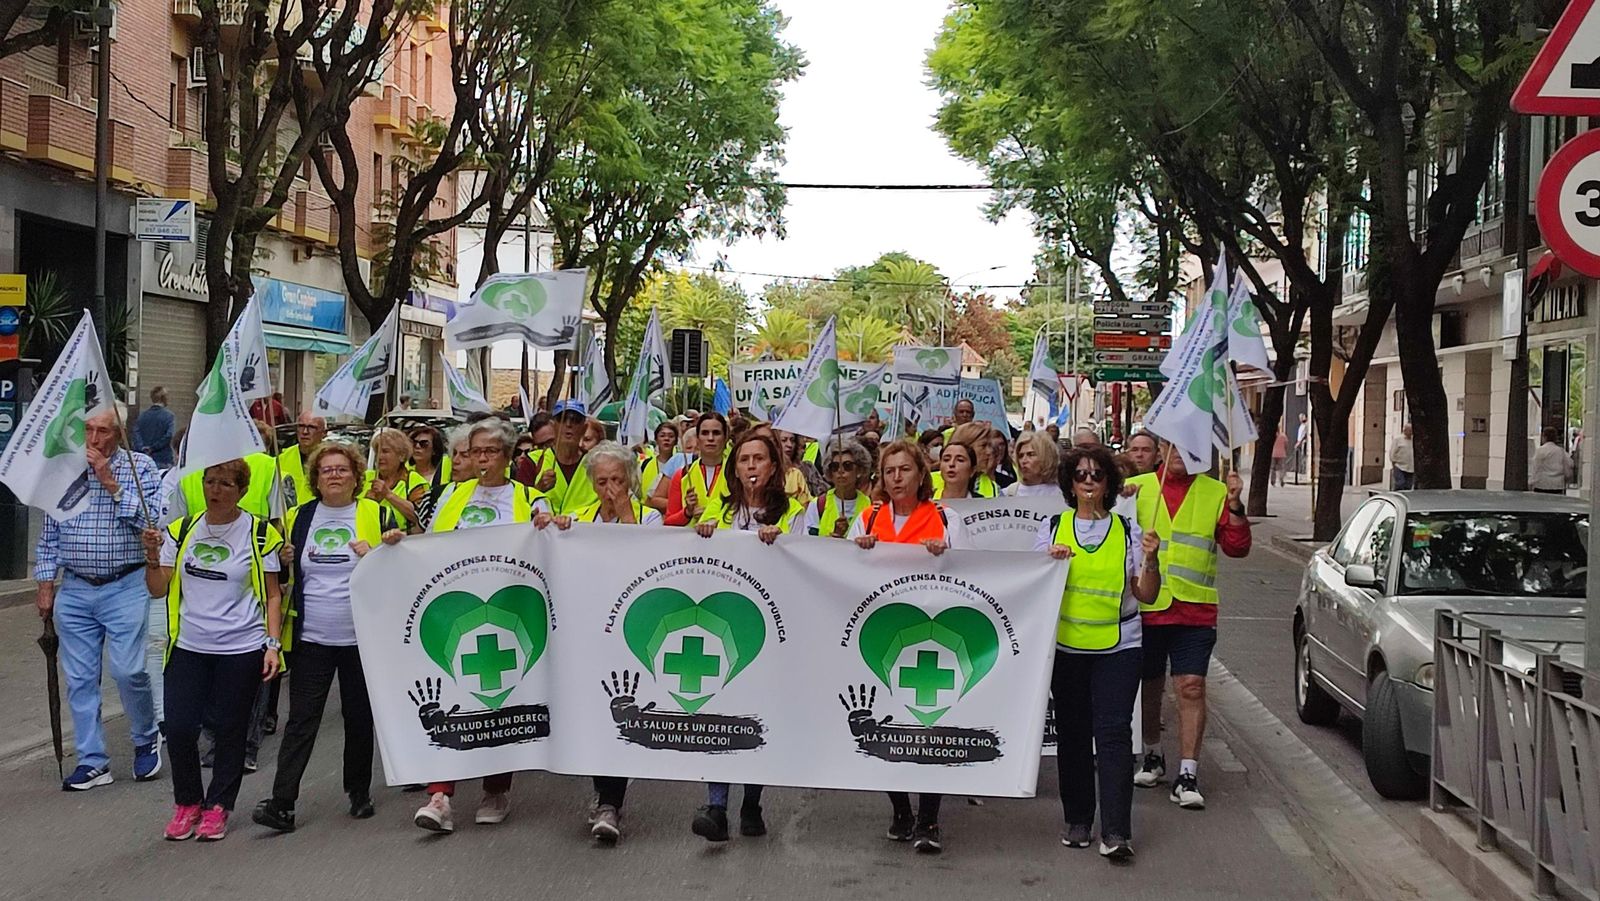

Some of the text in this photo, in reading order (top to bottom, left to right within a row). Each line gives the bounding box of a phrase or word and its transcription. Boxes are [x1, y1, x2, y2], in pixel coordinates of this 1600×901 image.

[1, 380, 14, 398] P
[963, 508, 1011, 526] EFENSA
[1014, 509, 1031, 519] DE
[989, 523, 1000, 531] DE
[1003, 522, 1014, 530] LA
[442, 571, 469, 587] AGUILAR
[491, 566, 527, 579] FRONTERA
[655, 567, 742, 588] AGUILAR DE LA FRONTERA
[403, 583, 433, 644] PLATAFORMA
[431, 572, 445, 584] EN
[444, 555, 487, 575] DEFENSA
[489, 554, 502, 562] DE
[504, 556, 516, 565] LA
[518, 560, 547, 589] SANID
[604, 556, 787, 644] PLATAFORMA EN DEFENSA DE LA SANIDAD PÚBLICA
[890, 585, 918, 598] AGUILAR
[919, 584, 929, 592] DE
[940, 585, 976, 602] FRONTERA
[840, 573, 1021, 656] PLATAFORMA EN DEFENSA DE LA SANIDAD PÚBLICA
[450, 721, 482, 733] SALUD
[484, 718, 496, 728] ES
[498, 717, 512, 726] UN
[460, 725, 537, 743] NO UN NEGOCIO!
[624, 720, 757, 736] ¡LA SALUD ES UN DERECHO,
[651, 733, 731, 746] NO UN NEGOCIO!
[862, 733, 994, 748] ¡LA SALUD ES UN DERECHO,
[889, 746, 968, 759] NO UN NEGOCIO!
